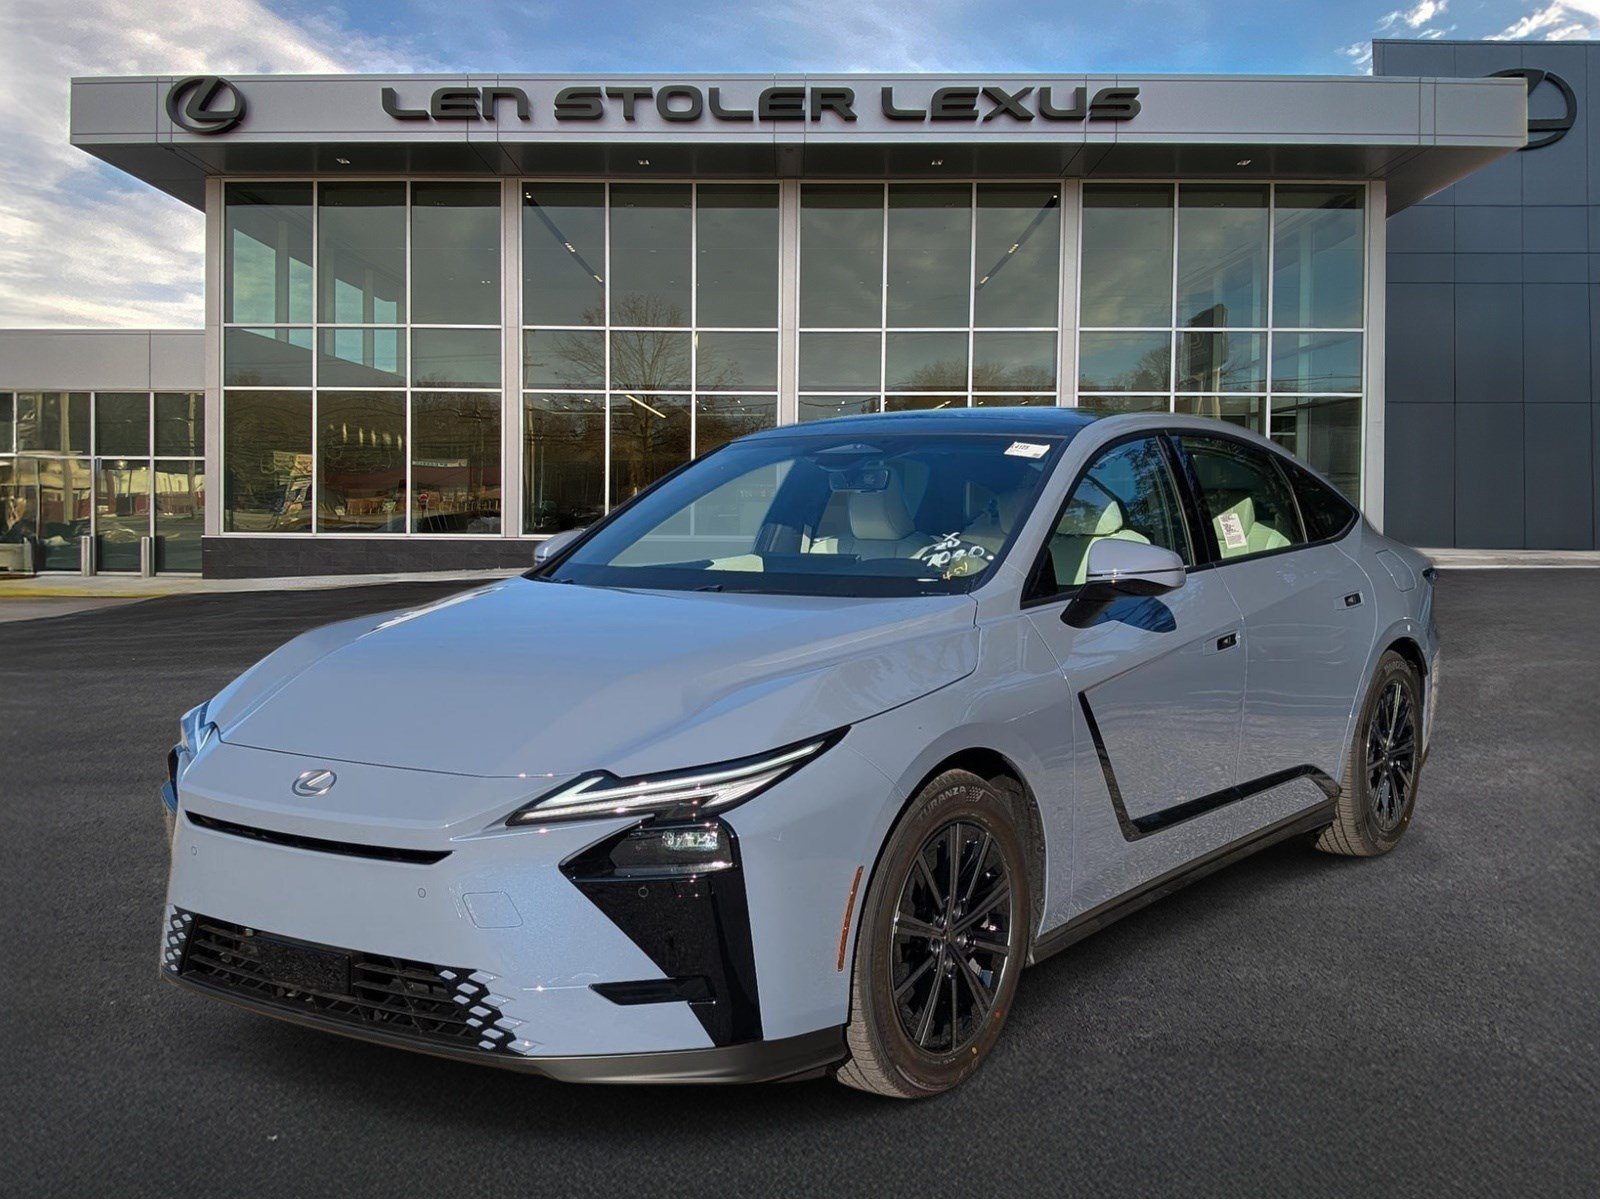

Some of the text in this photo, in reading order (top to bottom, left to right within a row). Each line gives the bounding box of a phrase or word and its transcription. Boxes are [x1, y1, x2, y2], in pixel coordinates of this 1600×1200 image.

[382, 84, 1143, 123] LEN STOLER LEXUS
[918, 785, 967, 821] TURANZA
